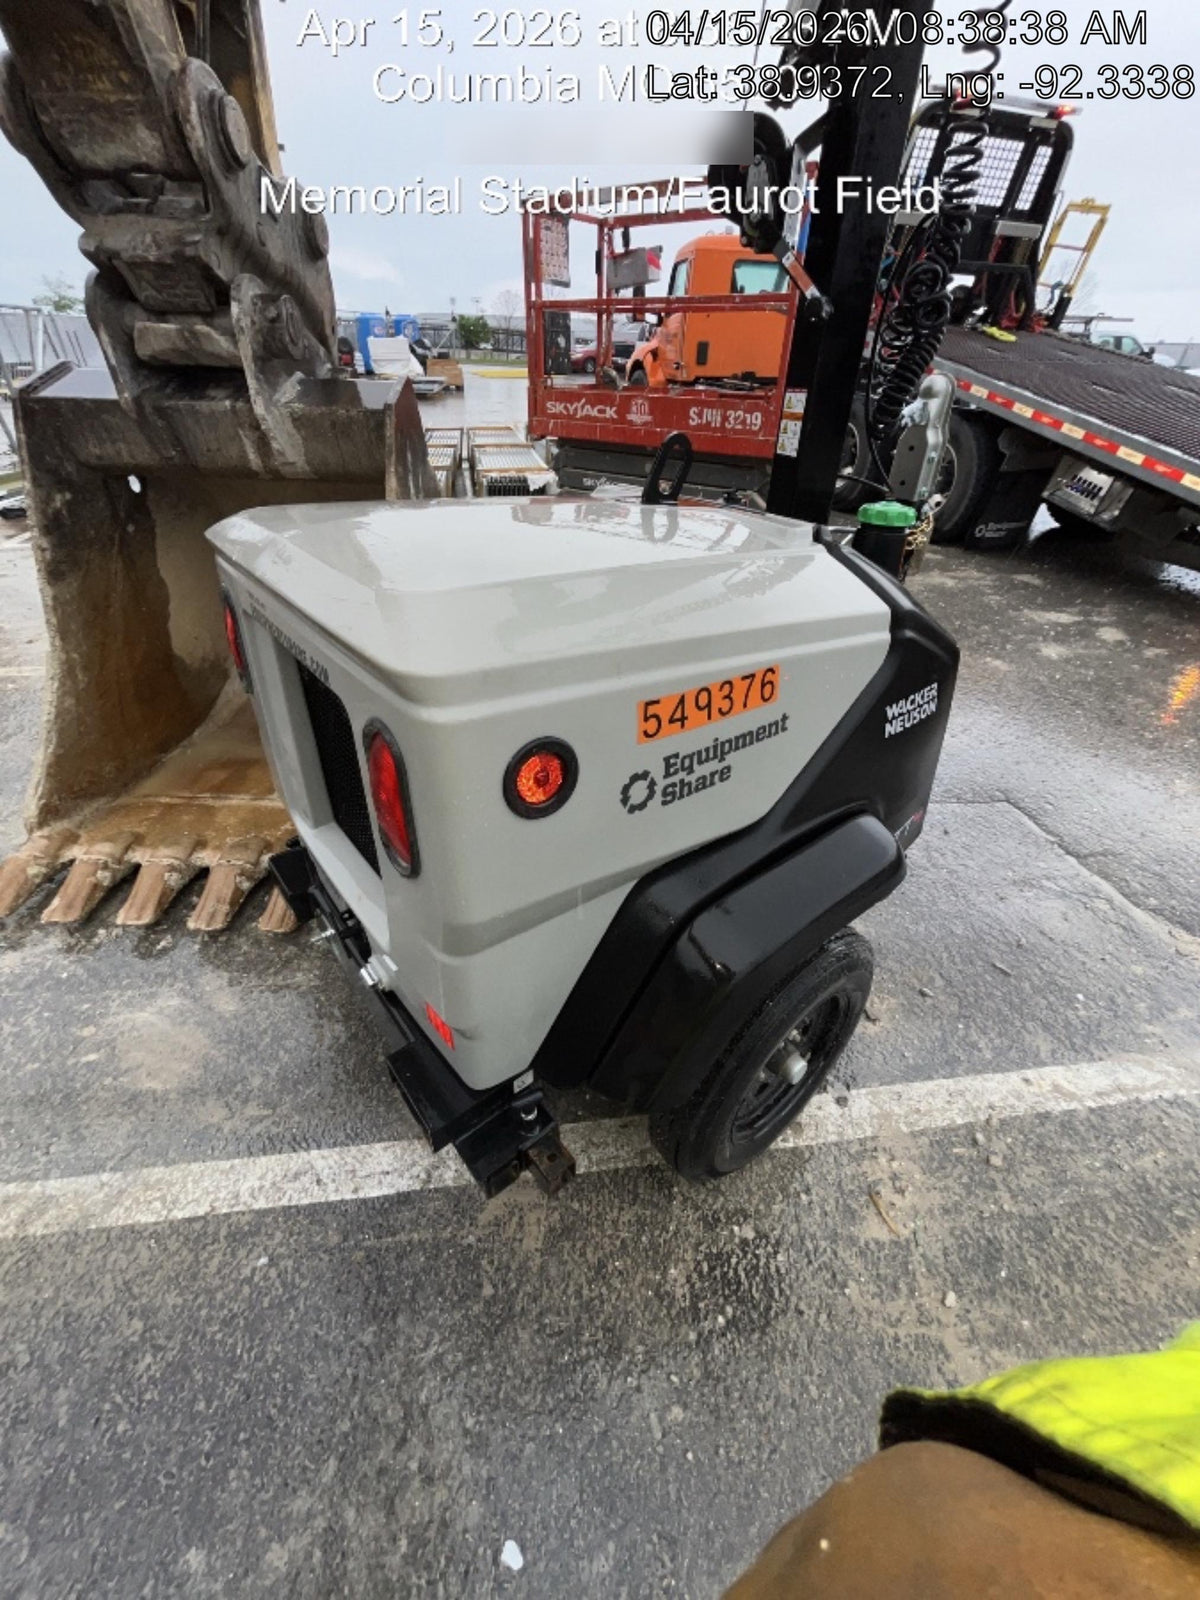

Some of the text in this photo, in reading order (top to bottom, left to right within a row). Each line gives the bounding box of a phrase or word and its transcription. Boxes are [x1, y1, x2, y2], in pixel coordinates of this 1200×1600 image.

[546, 398, 618, 419] SKYJACK
[724, 410, 762, 431] 3219
[642, 666, 777, 739] 549376
[884, 698, 938, 739] NEUSON
[885, 682, 938, 721] WACKER
[662, 712, 790, 780] Equipment
[661, 765, 732, 807] Share
